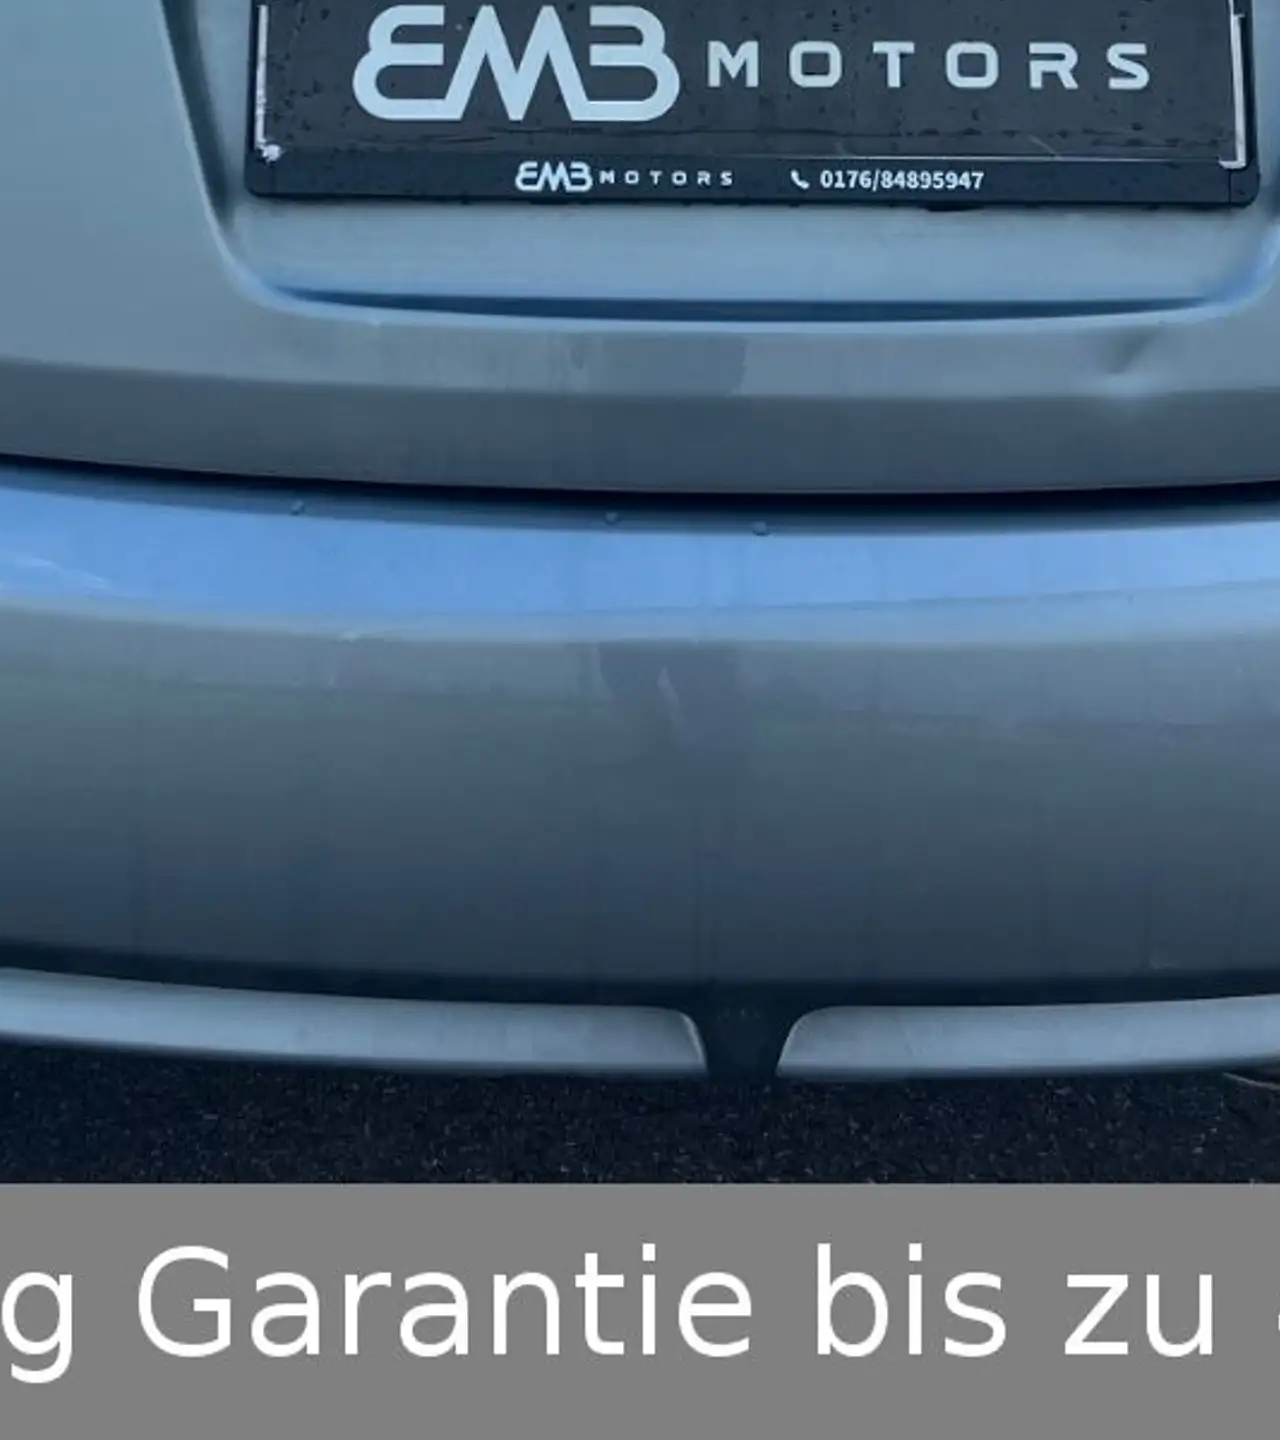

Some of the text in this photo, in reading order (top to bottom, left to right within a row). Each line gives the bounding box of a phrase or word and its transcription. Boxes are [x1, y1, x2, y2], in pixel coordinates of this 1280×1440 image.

[353, 5, 1150, 122] EMB MOTORS
[514, 161, 986, 194] EMB MOTORS 0176/84895947
